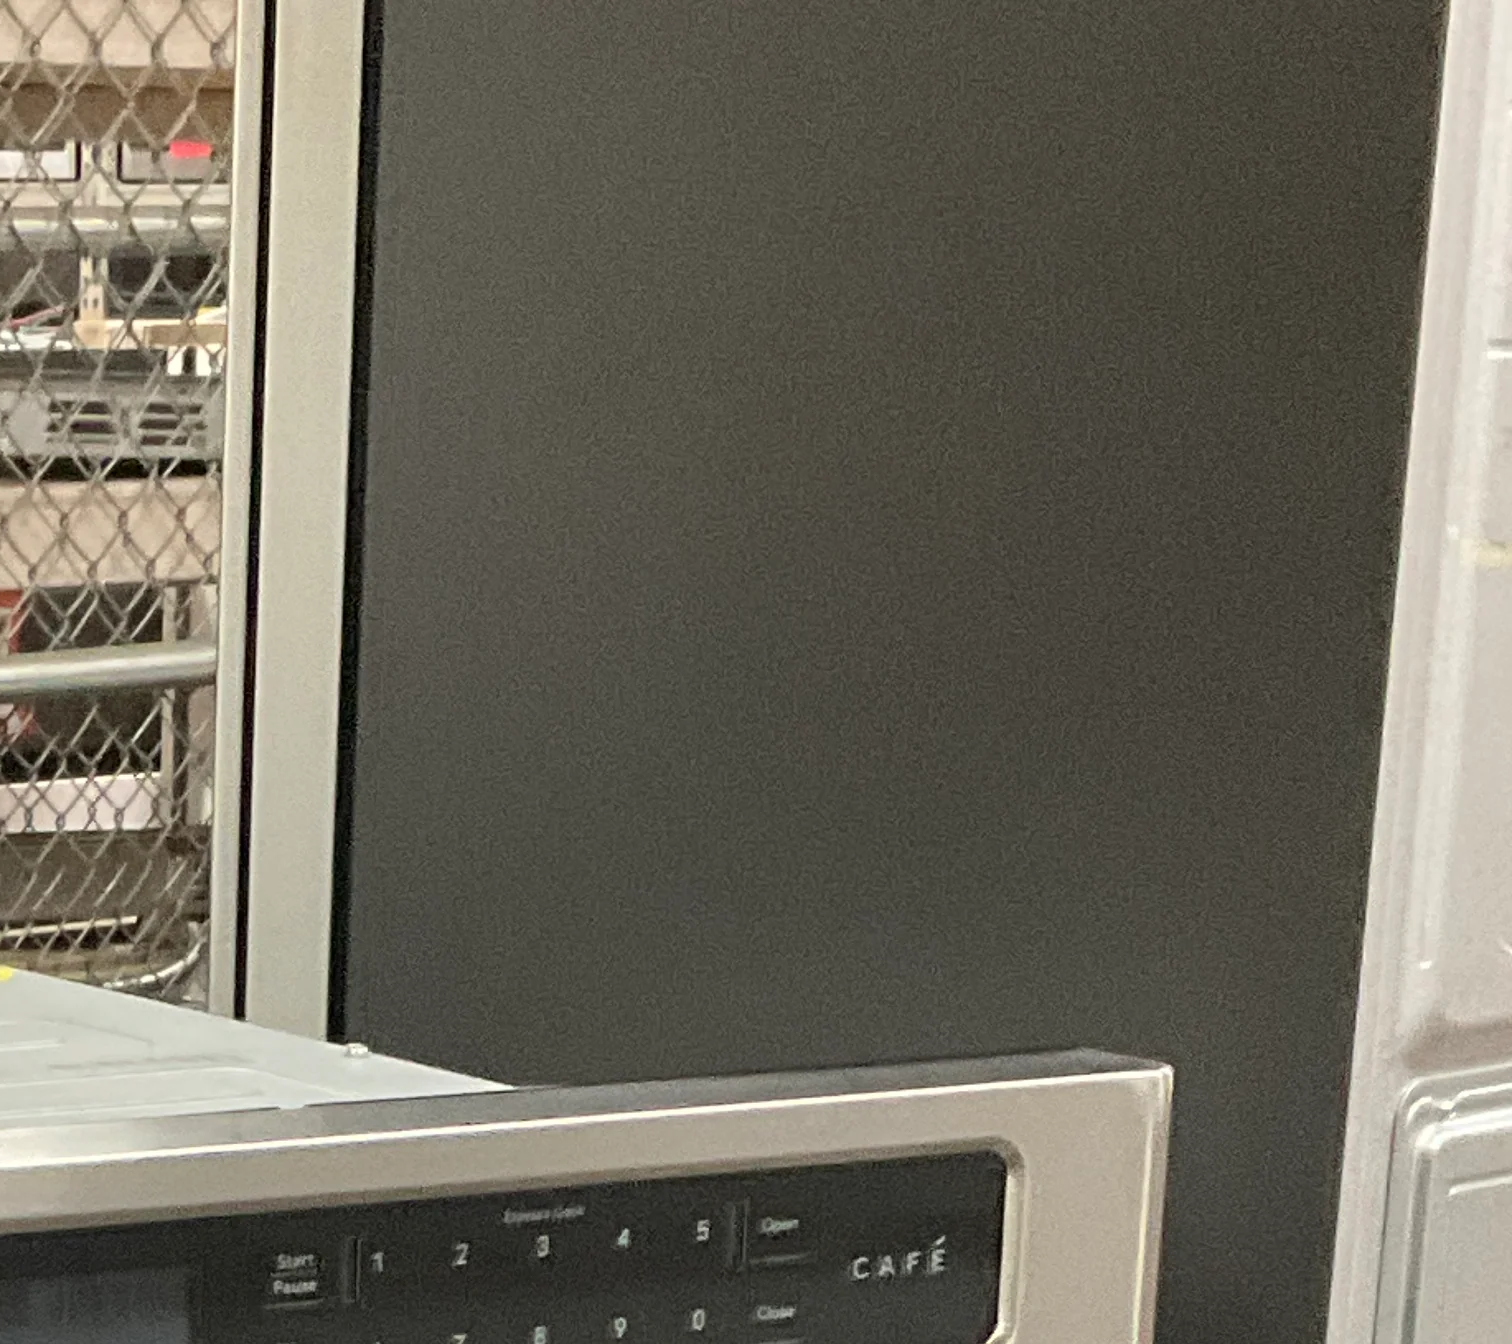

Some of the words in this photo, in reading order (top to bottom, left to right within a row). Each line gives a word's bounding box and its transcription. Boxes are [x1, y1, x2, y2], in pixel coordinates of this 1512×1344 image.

[371, 1252, 384, 1273] 1
[453, 1243, 469, 1266] 2
[537, 1235, 550, 1258] 3
[616, 1228, 631, 1248] 4
[696, 1219, 710, 1242] 5
[850, 1235, 946, 1280] CAFÉ
[614, 1317, 627, 1338] 9
[692, 1308, 705, 1331] 0
